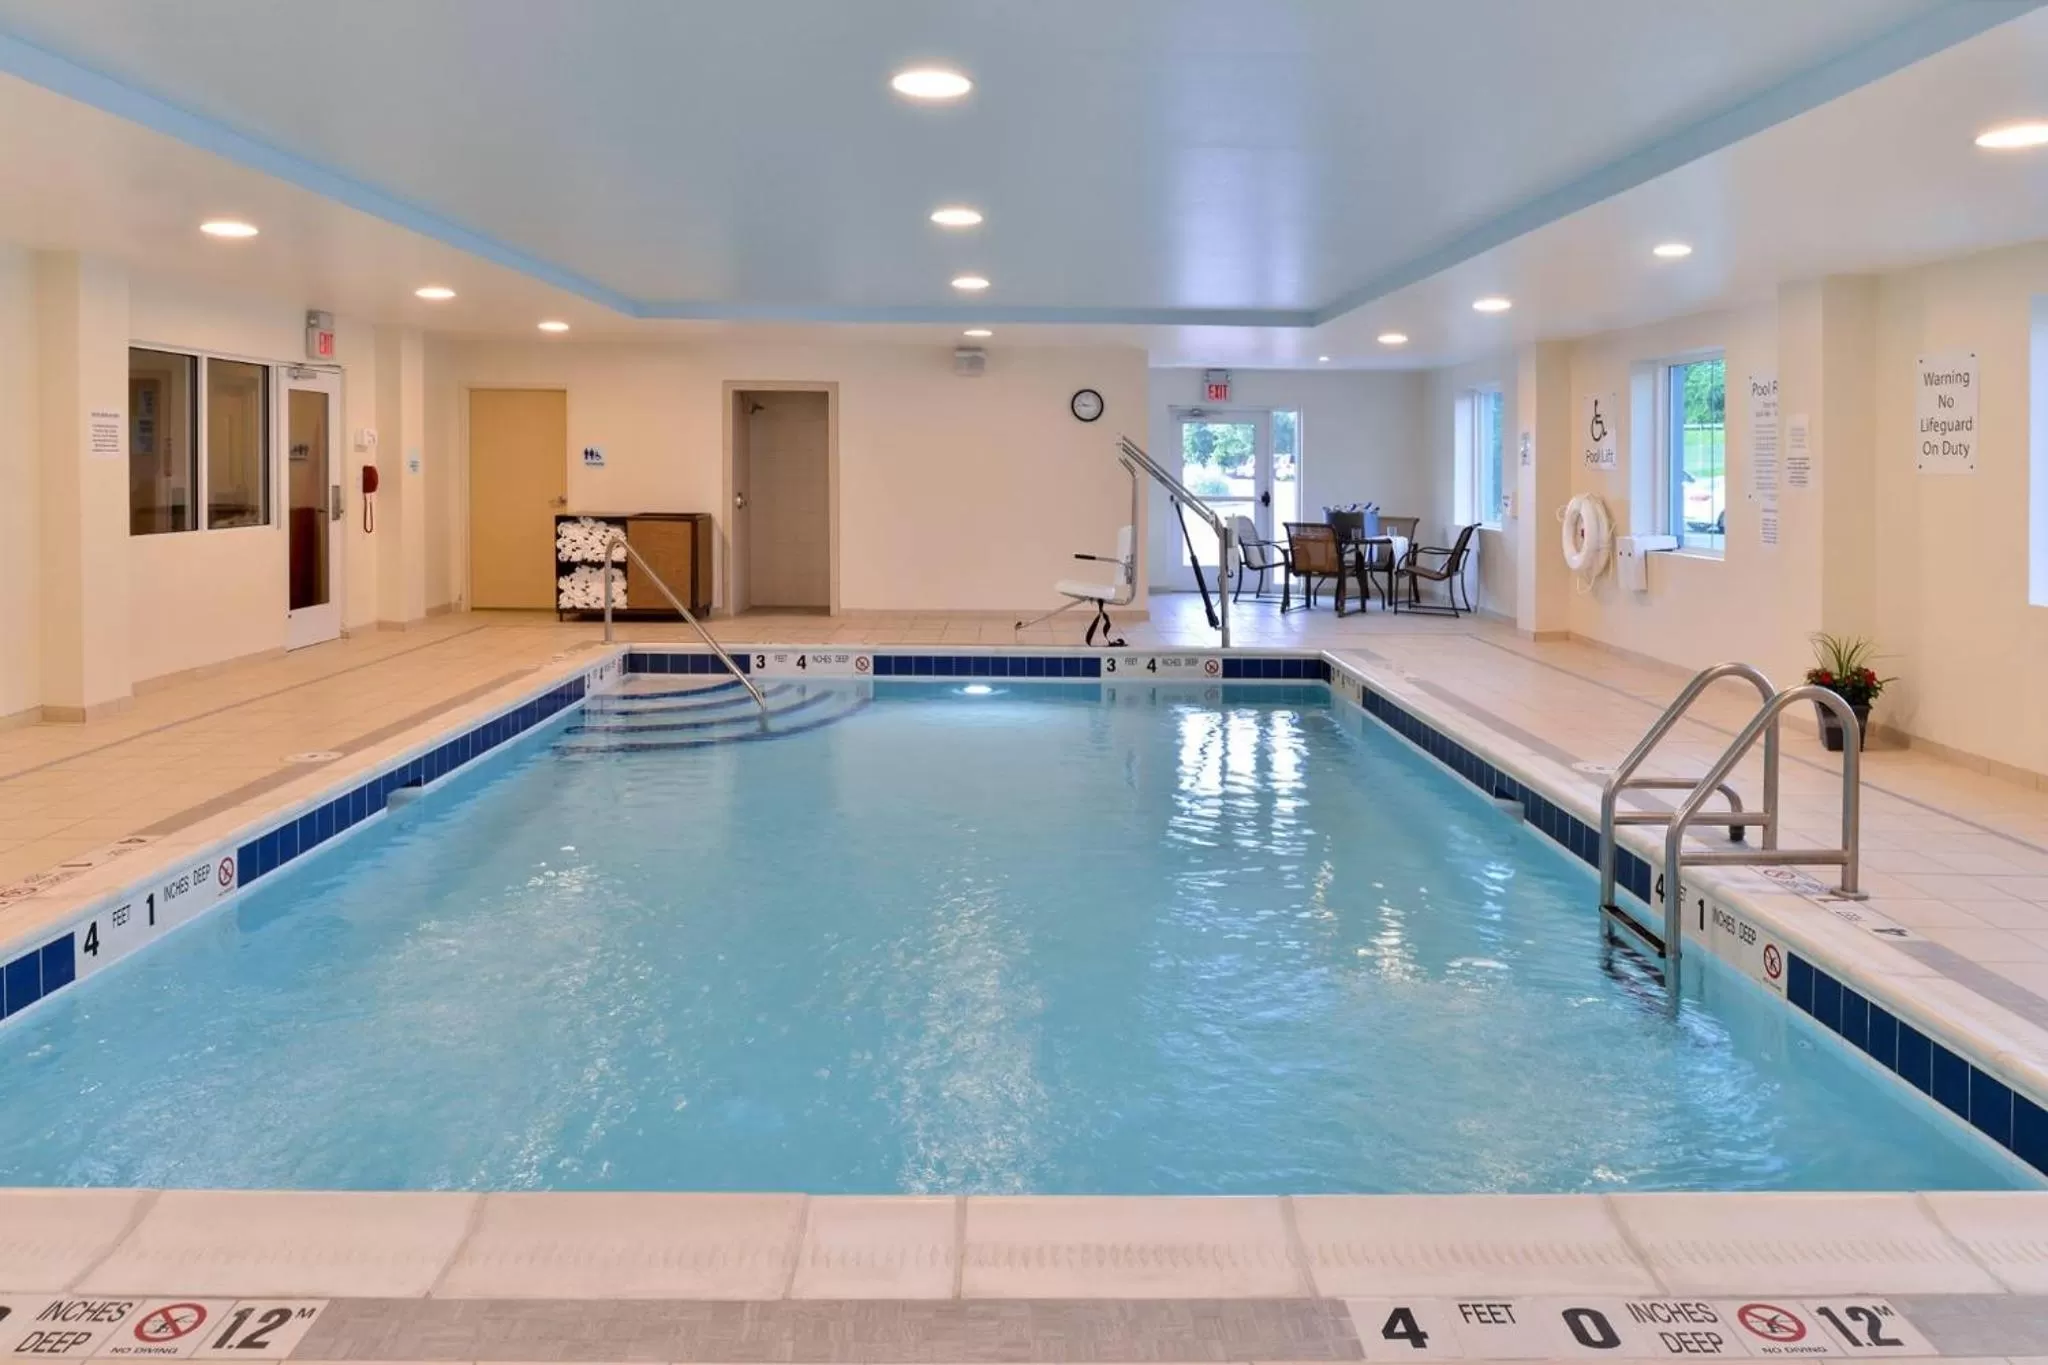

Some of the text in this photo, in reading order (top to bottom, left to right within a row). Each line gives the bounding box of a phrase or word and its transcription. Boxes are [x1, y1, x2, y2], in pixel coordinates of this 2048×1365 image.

[1923, 369, 1970, 388] Warning
[1208, 384, 1228, 401] EXIT
[1752, 381, 1771, 397] Pool
[1938, 394, 1955, 409] No
[1920, 417, 1973, 436] Lifeguard
[1586, 449, 1601, 463] Pool
[1922, 440, 1970, 459] On Duty
[756, 654, 766, 669] 3
[796, 654, 807, 670] 4
[1106, 658, 1116, 672] 3
[1146, 657, 1157, 673] 4
[84, 863, 211, 957] 4 FEET 1 INCHES DEEP
[1655, 873, 1665, 904] 4
[1698, 898, 1705, 931] 1
[36, 1301, 133, 1322] INCHES
[1625, 1302, 1719, 1324] INCHES
[1381, 1304, 1622, 1349] 4 FEET 0
[14, 1331, 93, 1353] DEEP
[111, 1346, 179, 1354] NO DIVING
[1658, 1331, 1724, 1354] DEEP
[1761, 1345, 1828, 1355] NO DIVING
